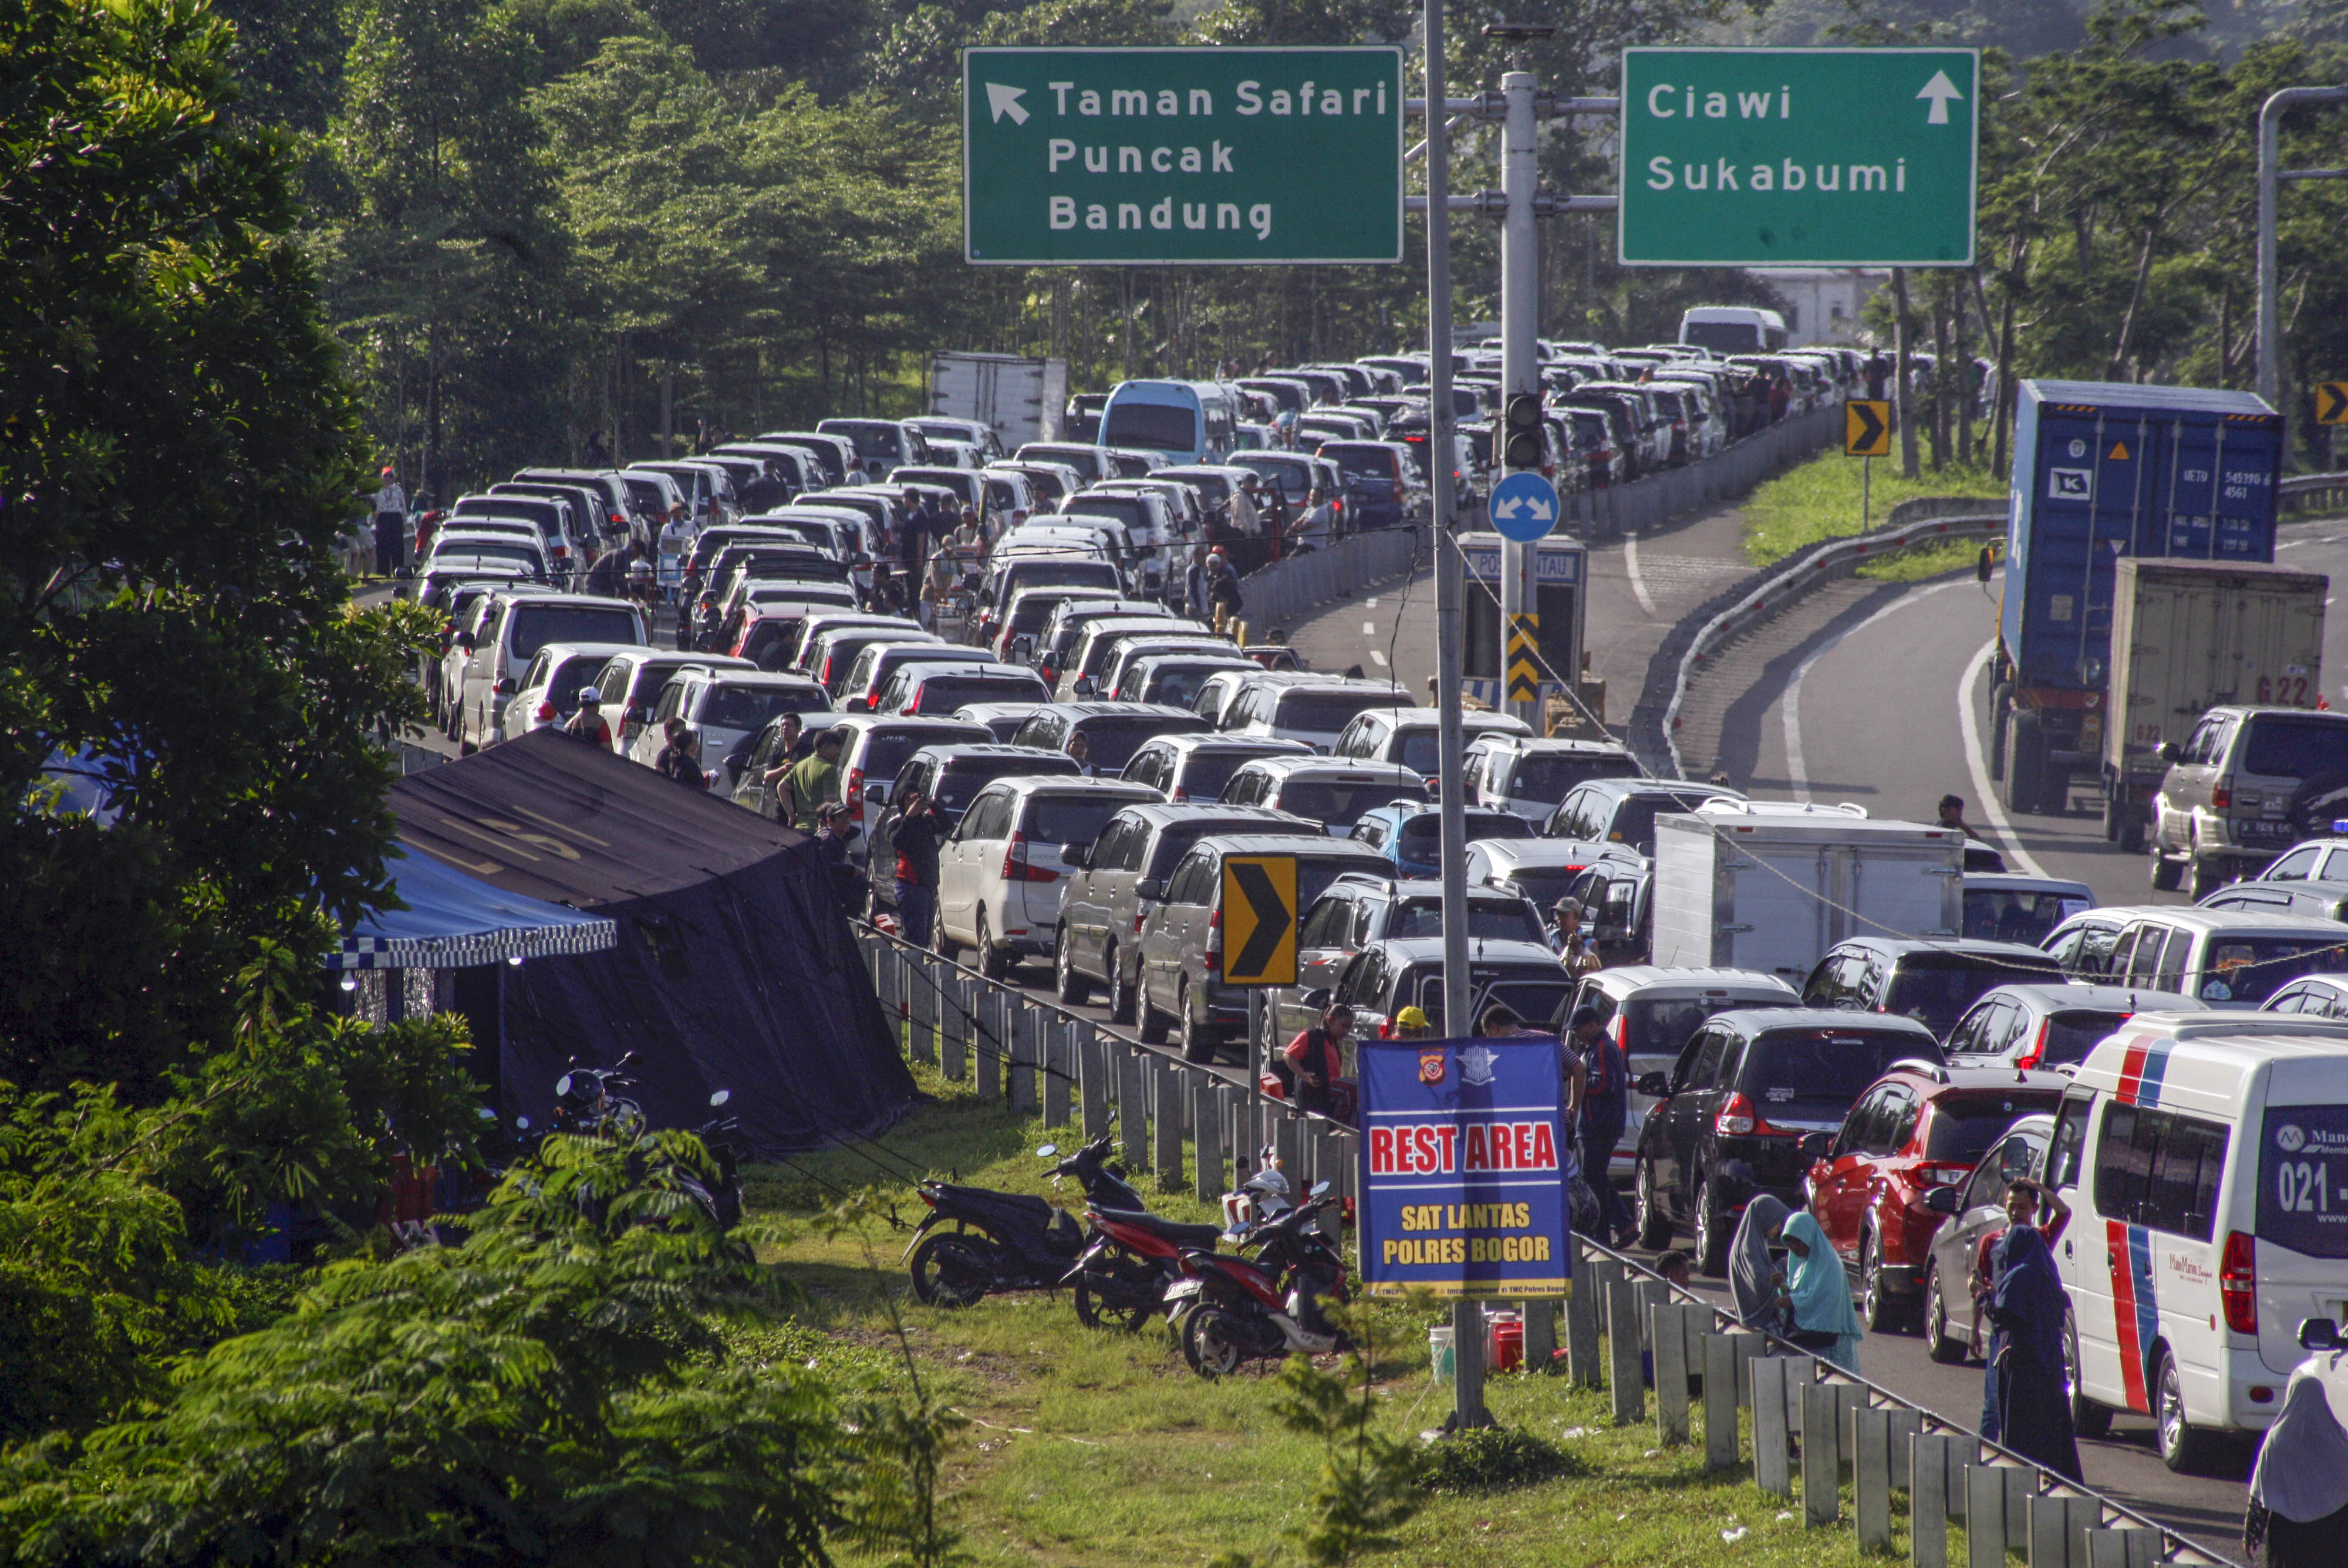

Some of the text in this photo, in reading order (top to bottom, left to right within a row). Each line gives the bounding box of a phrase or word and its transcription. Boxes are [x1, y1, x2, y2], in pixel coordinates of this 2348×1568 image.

[1048, 80, 1386, 116] Taman Safari
[1648, 84, 1790, 119] Ciawi
[1049, 138, 1234, 173] Puncak
[1647, 156, 1906, 192] Sukabumi
[1049, 195, 1271, 240] Bandung
[2063, 477, 2080, 490] K
[1369, 1122, 1558, 1175] REST AREA
[2279, 1161, 2327, 1212] 021
[1401, 1202, 1530, 1231] SAT LANTAS
[1382, 1236, 1550, 1265] POLRES BOGOR
